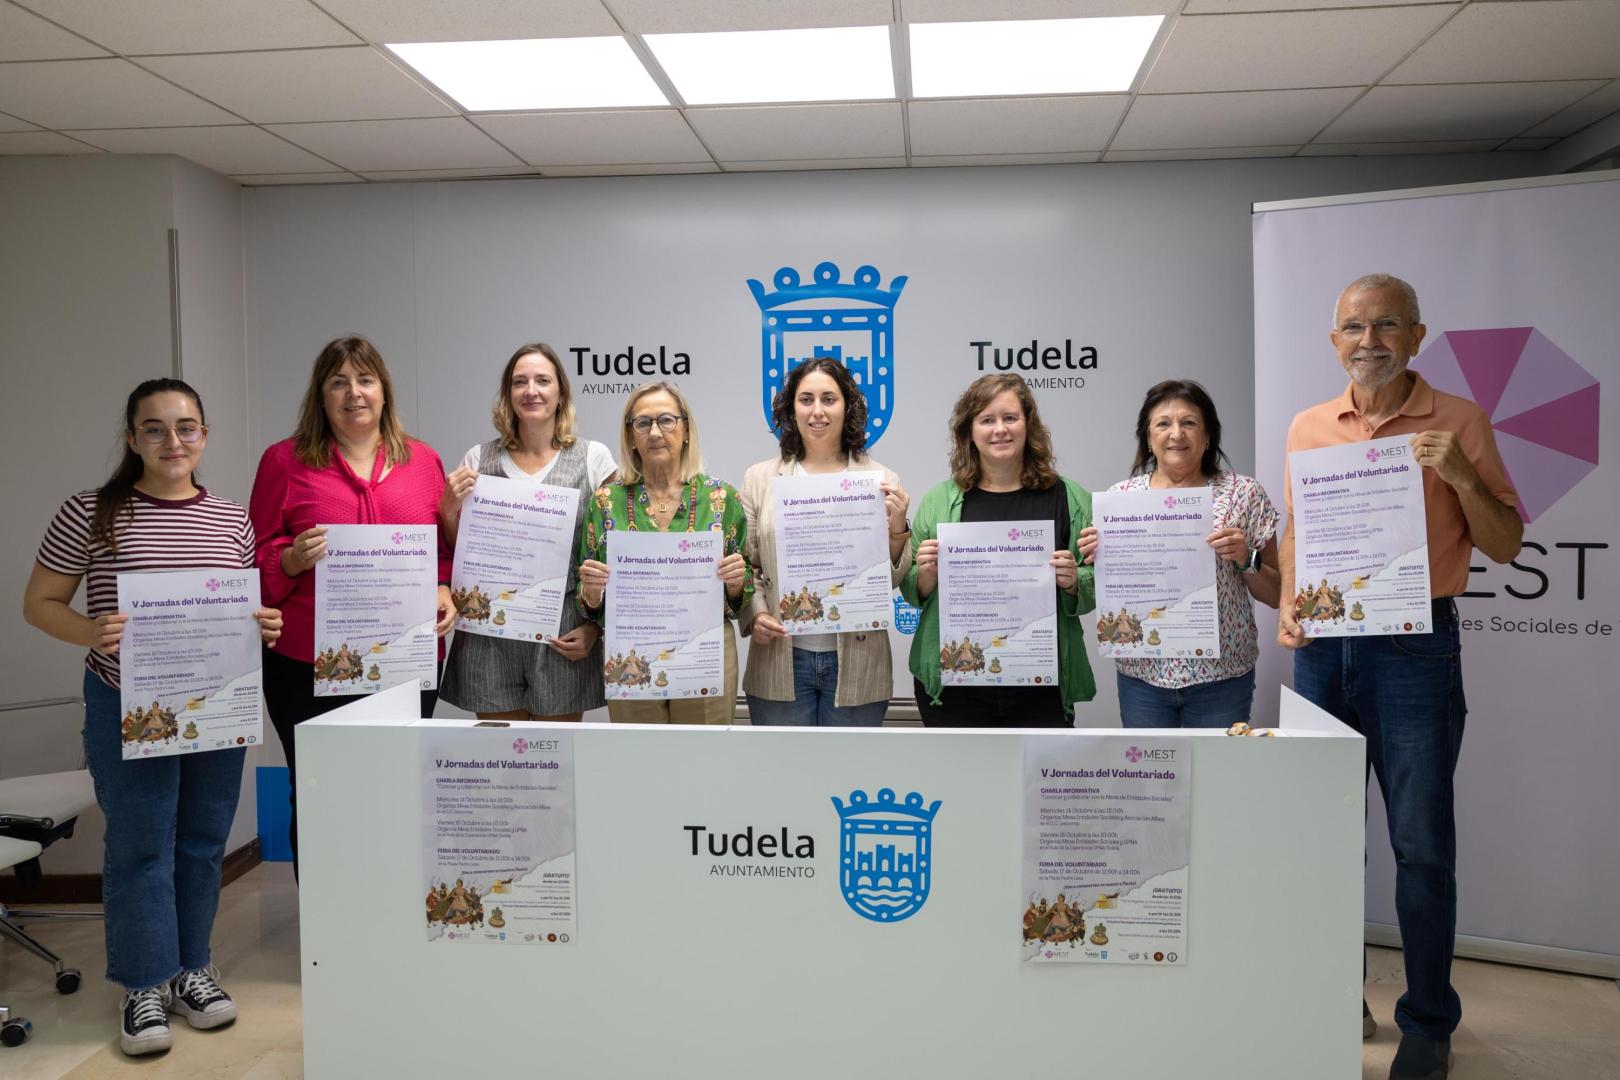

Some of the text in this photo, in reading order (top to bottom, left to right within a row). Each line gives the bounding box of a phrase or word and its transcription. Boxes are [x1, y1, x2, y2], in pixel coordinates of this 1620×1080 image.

[969, 339, 1098, 371] Tudela
[569, 346, 691, 376] Tudela
[1026, 377, 1085, 389] AMIENTO
[1381, 447, 1408, 457] MEST
[1309, 473, 1343, 484] Jornadas
[1344, 471, 1356, 480] del
[1356, 464, 1409, 477] Voluntariado
[546, 494, 569, 502] MEST
[831, 493, 875, 502] Voluntariado
[479, 498, 511, 507] Jornadas
[522, 504, 567, 516] Voluntariado
[1154, 513, 1202, 521] Voluntariado
[222, 580, 248, 588] MEST
[140, 599, 179, 607] Jornadas
[194, 596, 248, 605] Voluntariado
[1490, 616, 1578, 635] Sociales
[1585, 620, 1613, 636] de
[529, 741, 559, 750] MEST
[1143, 750, 1176, 759] MEST
[435, 760, 559, 769] V Jornadas del Voluntariado
[1041, 769, 1175, 779] V Jornadas del Voluntariado
[683, 825, 815, 859] Tudela
[710, 864, 815, 878] AYUNTAMIENTO
